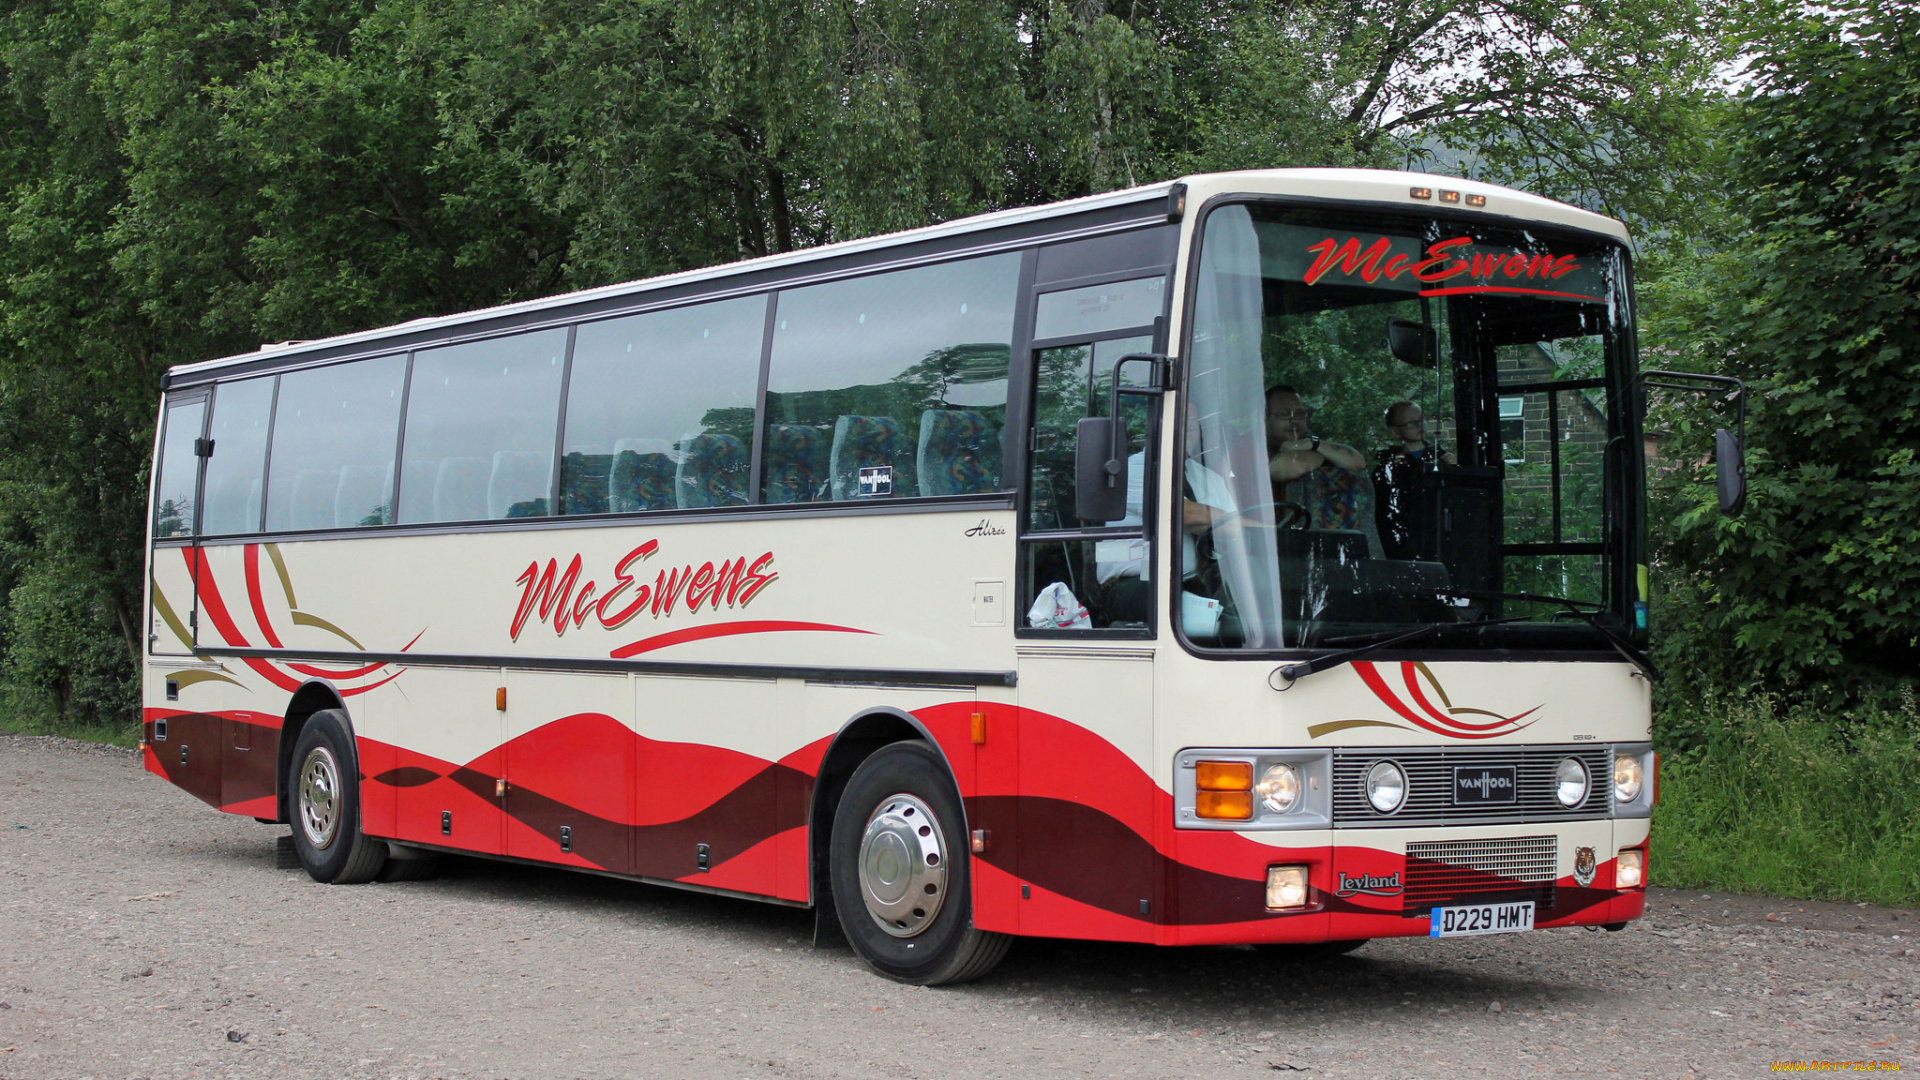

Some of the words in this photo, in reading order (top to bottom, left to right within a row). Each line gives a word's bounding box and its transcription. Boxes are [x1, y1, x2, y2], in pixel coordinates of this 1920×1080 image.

[1303, 236, 1582, 286] McEwens
[510, 538, 779, 643] McEwens
[1334, 872, 1404, 897] Leyland
[1444, 908, 1492, 932] D229
[1497, 905, 1531, 928] HMT
